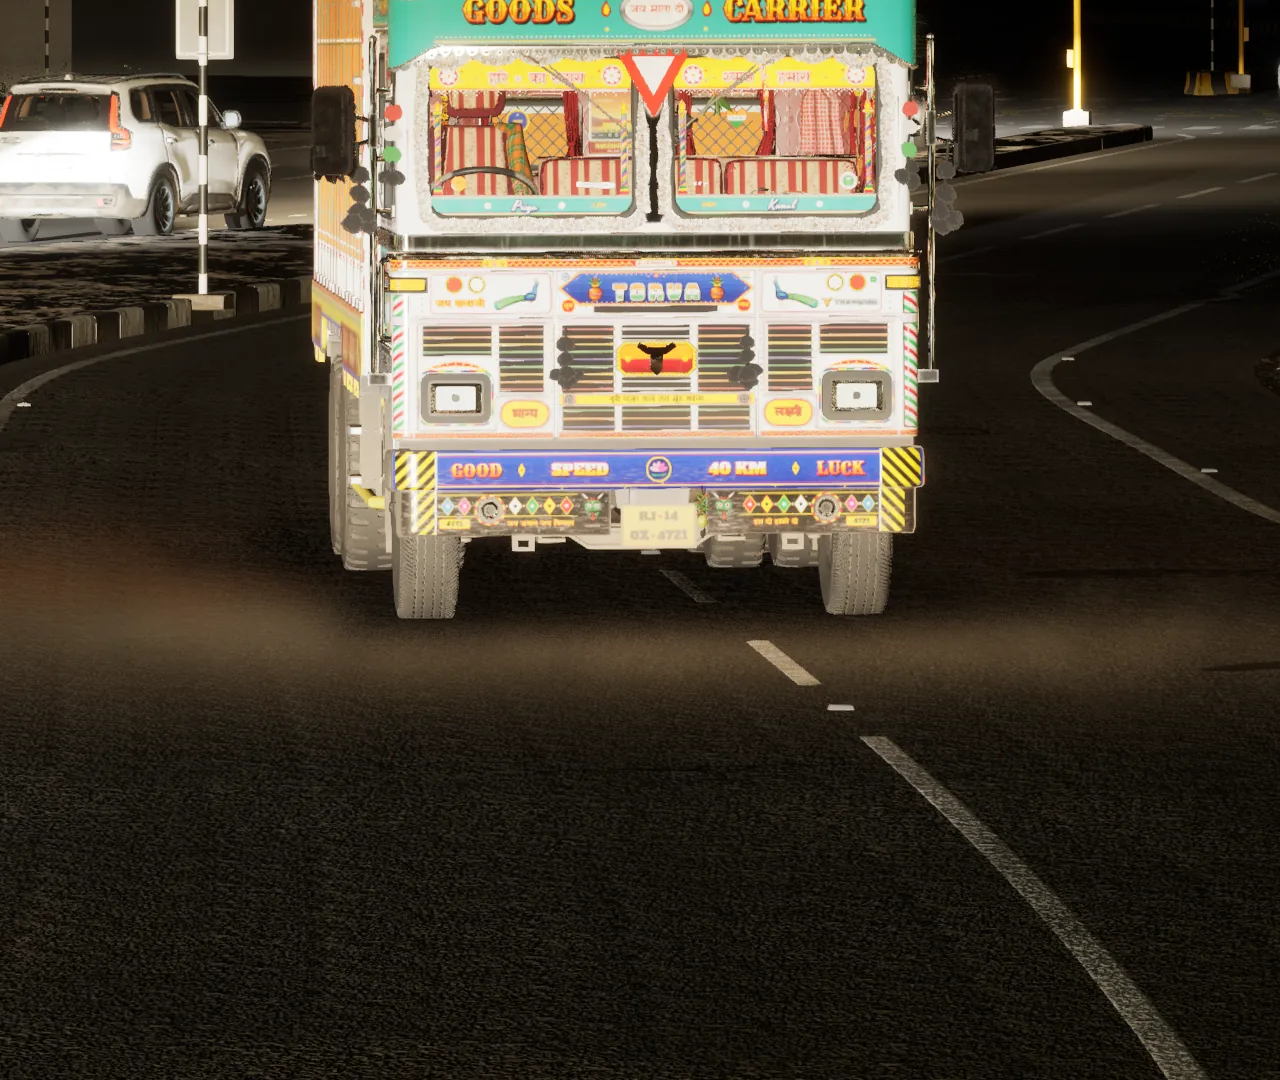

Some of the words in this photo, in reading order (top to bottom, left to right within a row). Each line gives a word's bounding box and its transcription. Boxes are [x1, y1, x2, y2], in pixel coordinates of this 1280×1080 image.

[631, 4, 647, 13] जय
[650, 4, 671, 13] माता
[674, 1, 685, 13] दी
[528, 72, 546, 84] का
[767, 198, 799, 212] Kunal
[450, 462, 503, 479] GOOD
[550, 461, 610, 478] SPEED
[708, 460, 733, 476] 40
[735, 460, 768, 476] KM
[816, 460, 866, 477] LUCK
